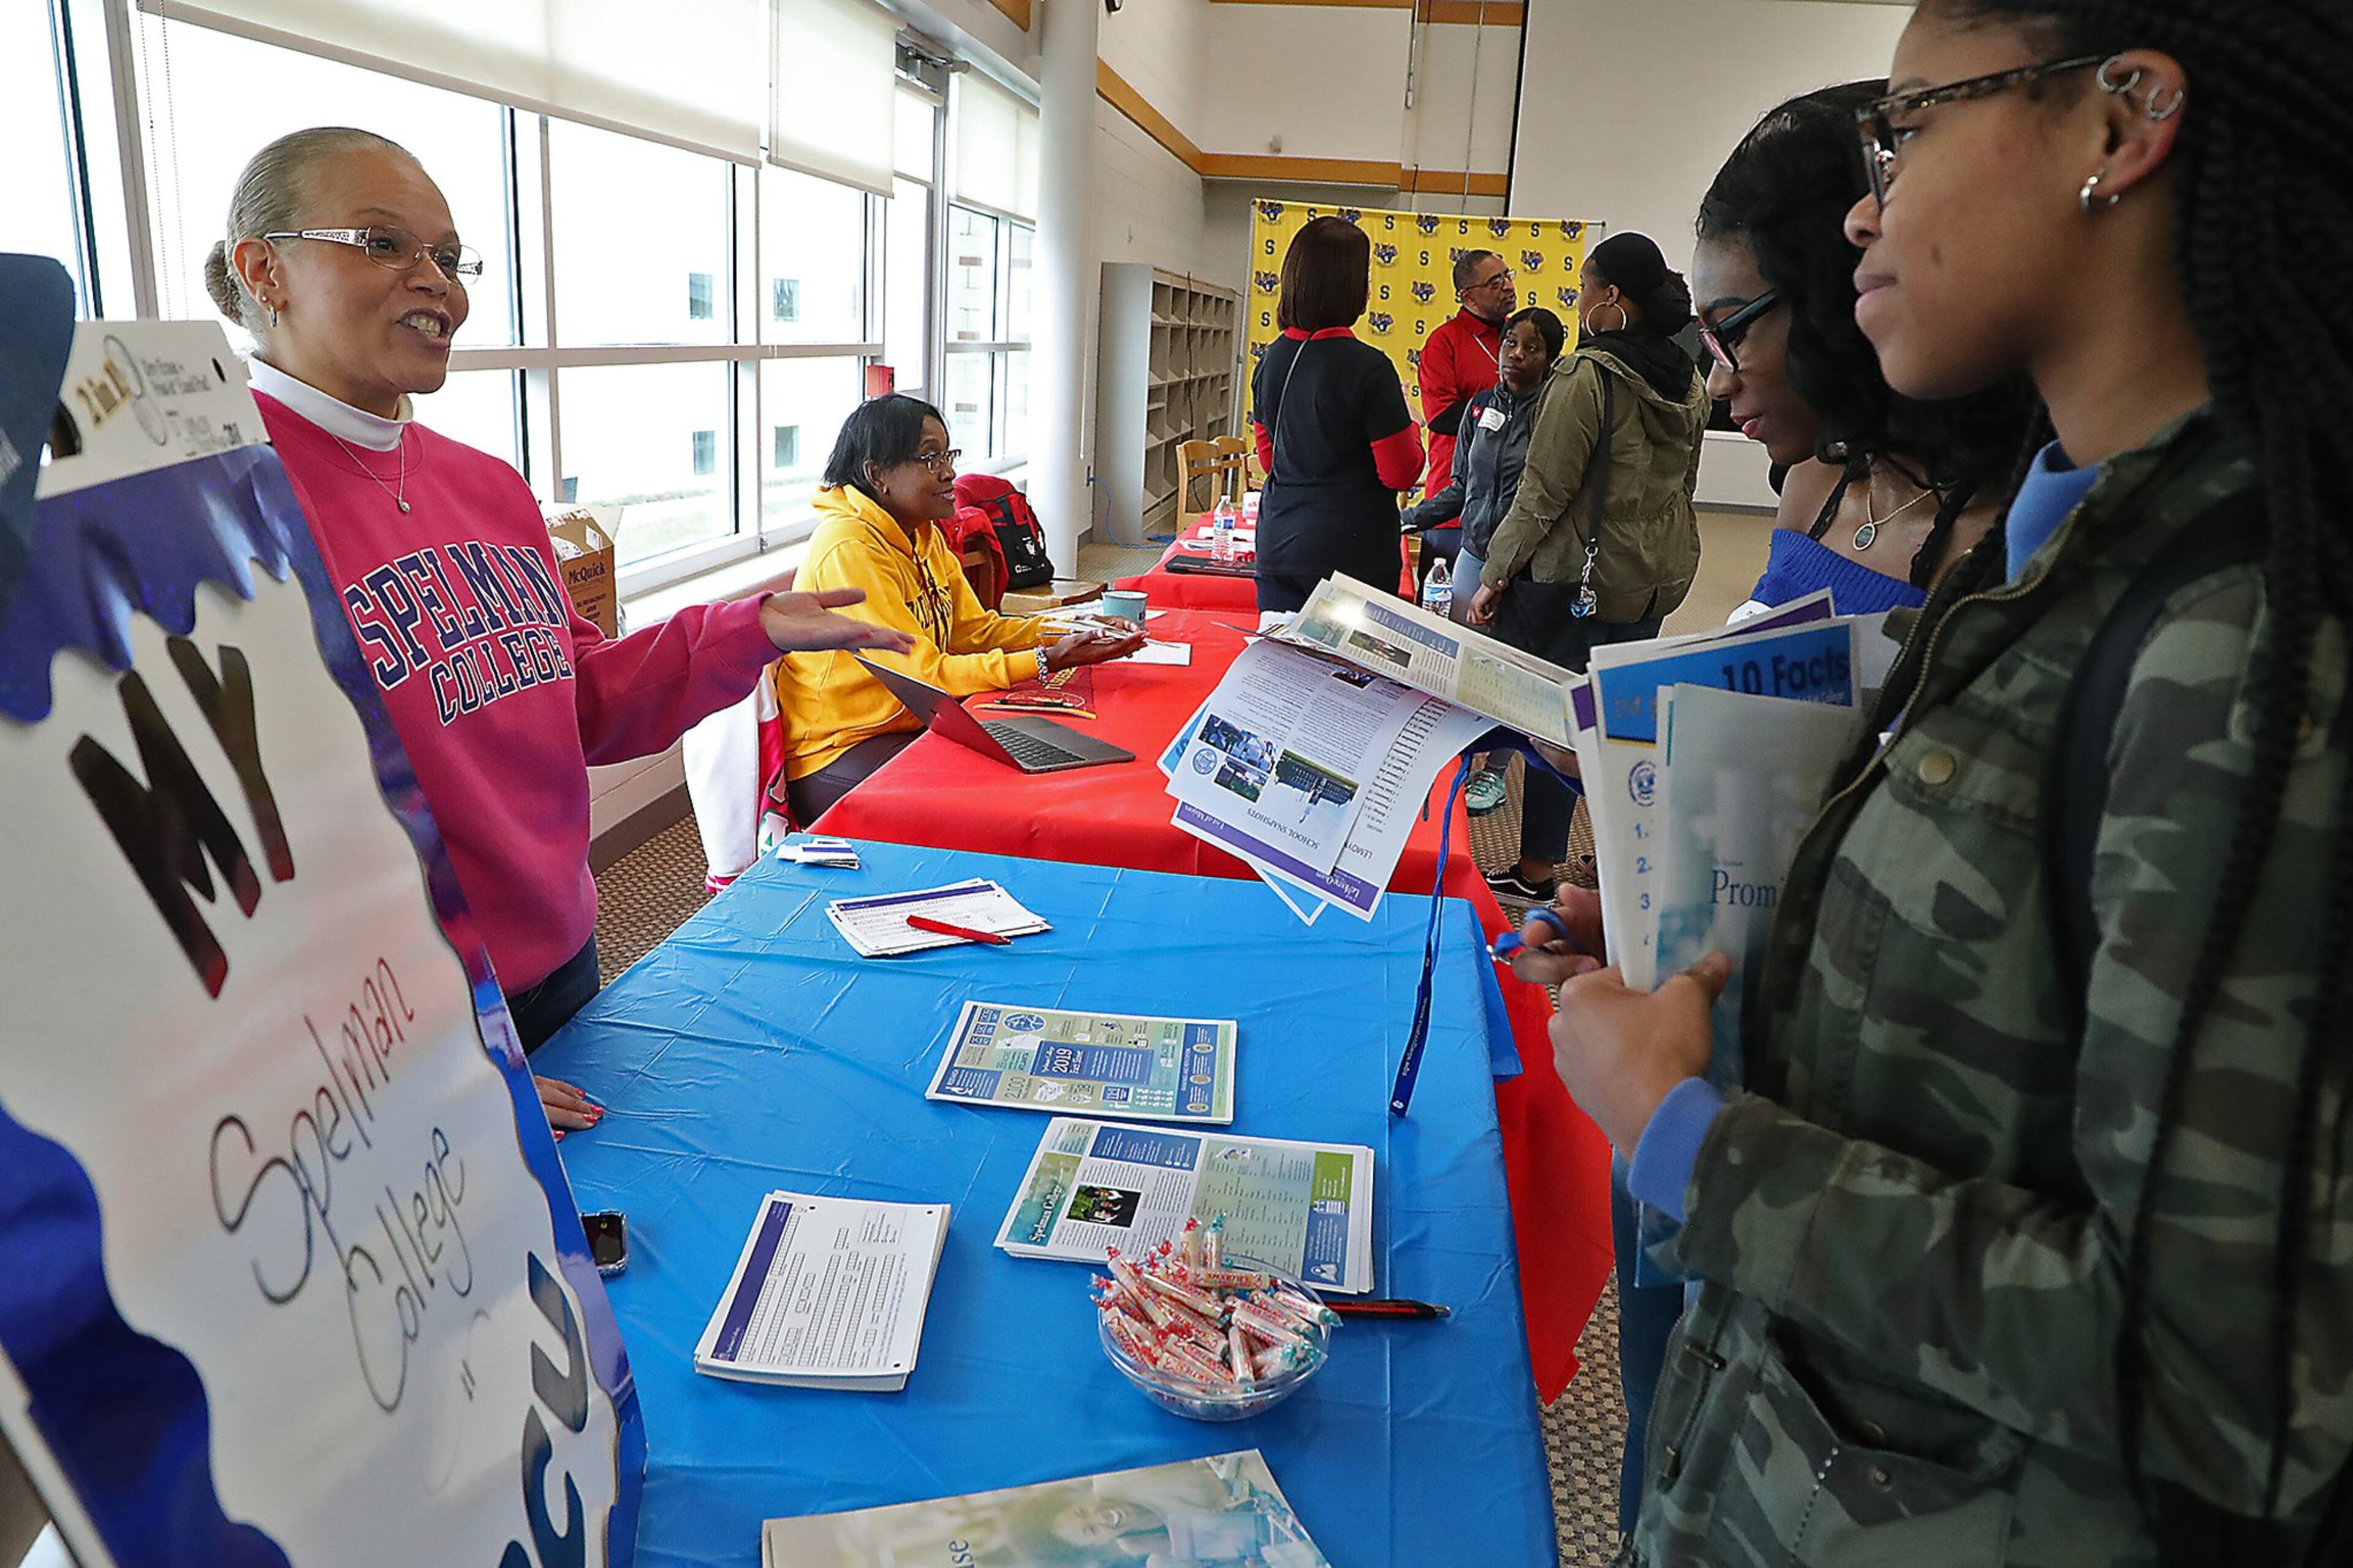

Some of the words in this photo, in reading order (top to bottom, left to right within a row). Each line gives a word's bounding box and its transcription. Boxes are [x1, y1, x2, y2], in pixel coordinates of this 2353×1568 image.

[1385, 215, 1395, 230] S
[1458, 220, 1469, 235] S
[1531, 222, 1540, 238] S
[1265, 239, 1275, 255] S
[1419, 251, 1430, 265] S
[1564, 256, 1573, 271] S
[1380, 285, 1390, 300] S
[1527, 291, 1537, 306] S
[1260, 311, 1271, 327] S
[1415, 319, 1425, 335] S
[1411, 385, 1420, 397] S
[569, 561, 606, 585] McQuick
[343, 540, 569, 691] SPELMAN
[429, 627, 575, 727] COLLEGE
[1722, 661, 1763, 696] 10
[1771, 645, 1852, 697] Facts
[69, 634, 295, 1001] MY
[1246, 808, 1288, 835] SNAPSHOTS
[1287, 828, 1320, 850] SCHOOL
[1634, 822, 1650, 840] 1.
[1344, 841, 1373, 860] LEMOY
[1636, 857, 1653, 874] 2.
[1710, 869, 1777, 907] Prom
[1051, 1048, 1074, 1073] 2019
[210, 956, 415, 1305] Spelman
[1029, 1210, 1053, 1243] Spelman
[347, 1126, 472, 1413] College
[1207, 1271, 1251, 1284] SMARTIES
